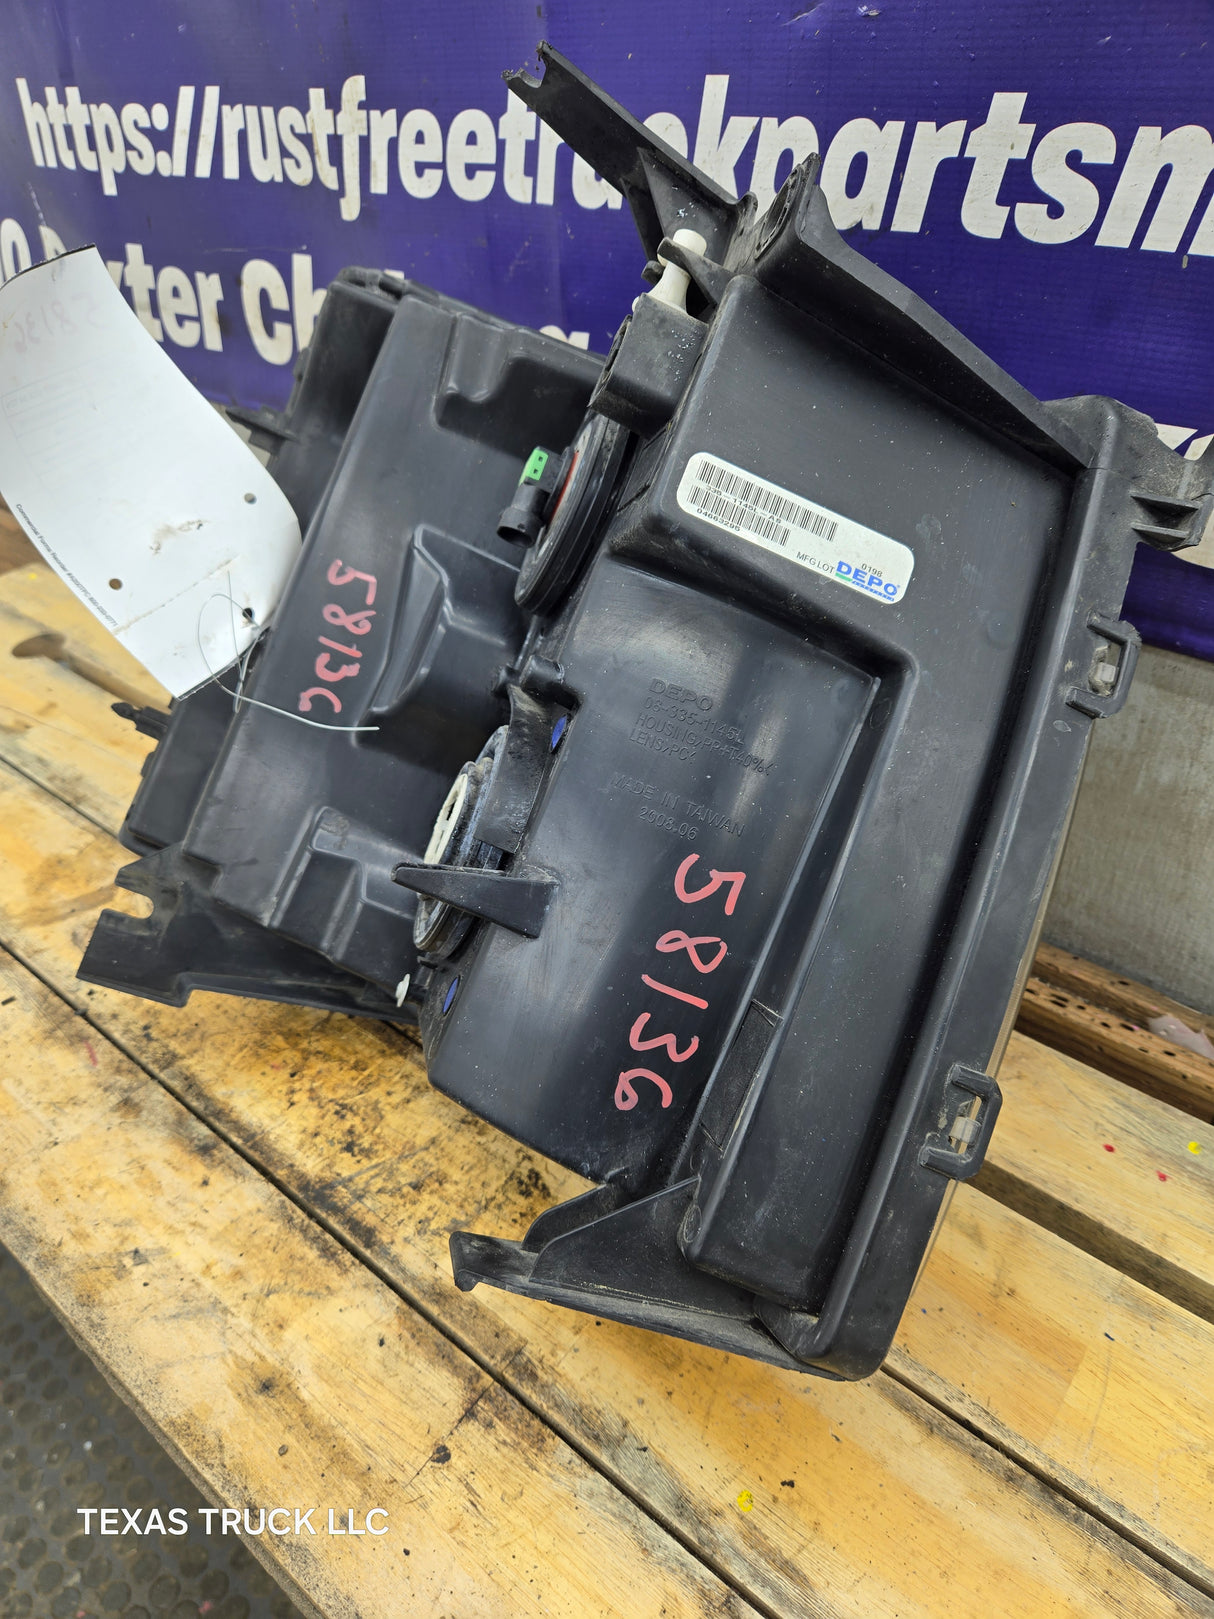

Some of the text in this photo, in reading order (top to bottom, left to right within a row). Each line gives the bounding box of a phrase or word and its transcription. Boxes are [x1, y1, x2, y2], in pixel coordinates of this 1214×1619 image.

[796, 552, 835, 575] MFG LOT
[836, 560, 899, 597] DEPO
[861, 563, 883, 578] 0198
[650, 678, 714, 712] DEPO
[611, 772, 746, 837] MADE IN TAIWAN
[615, 853, 746, 1111] 58136
